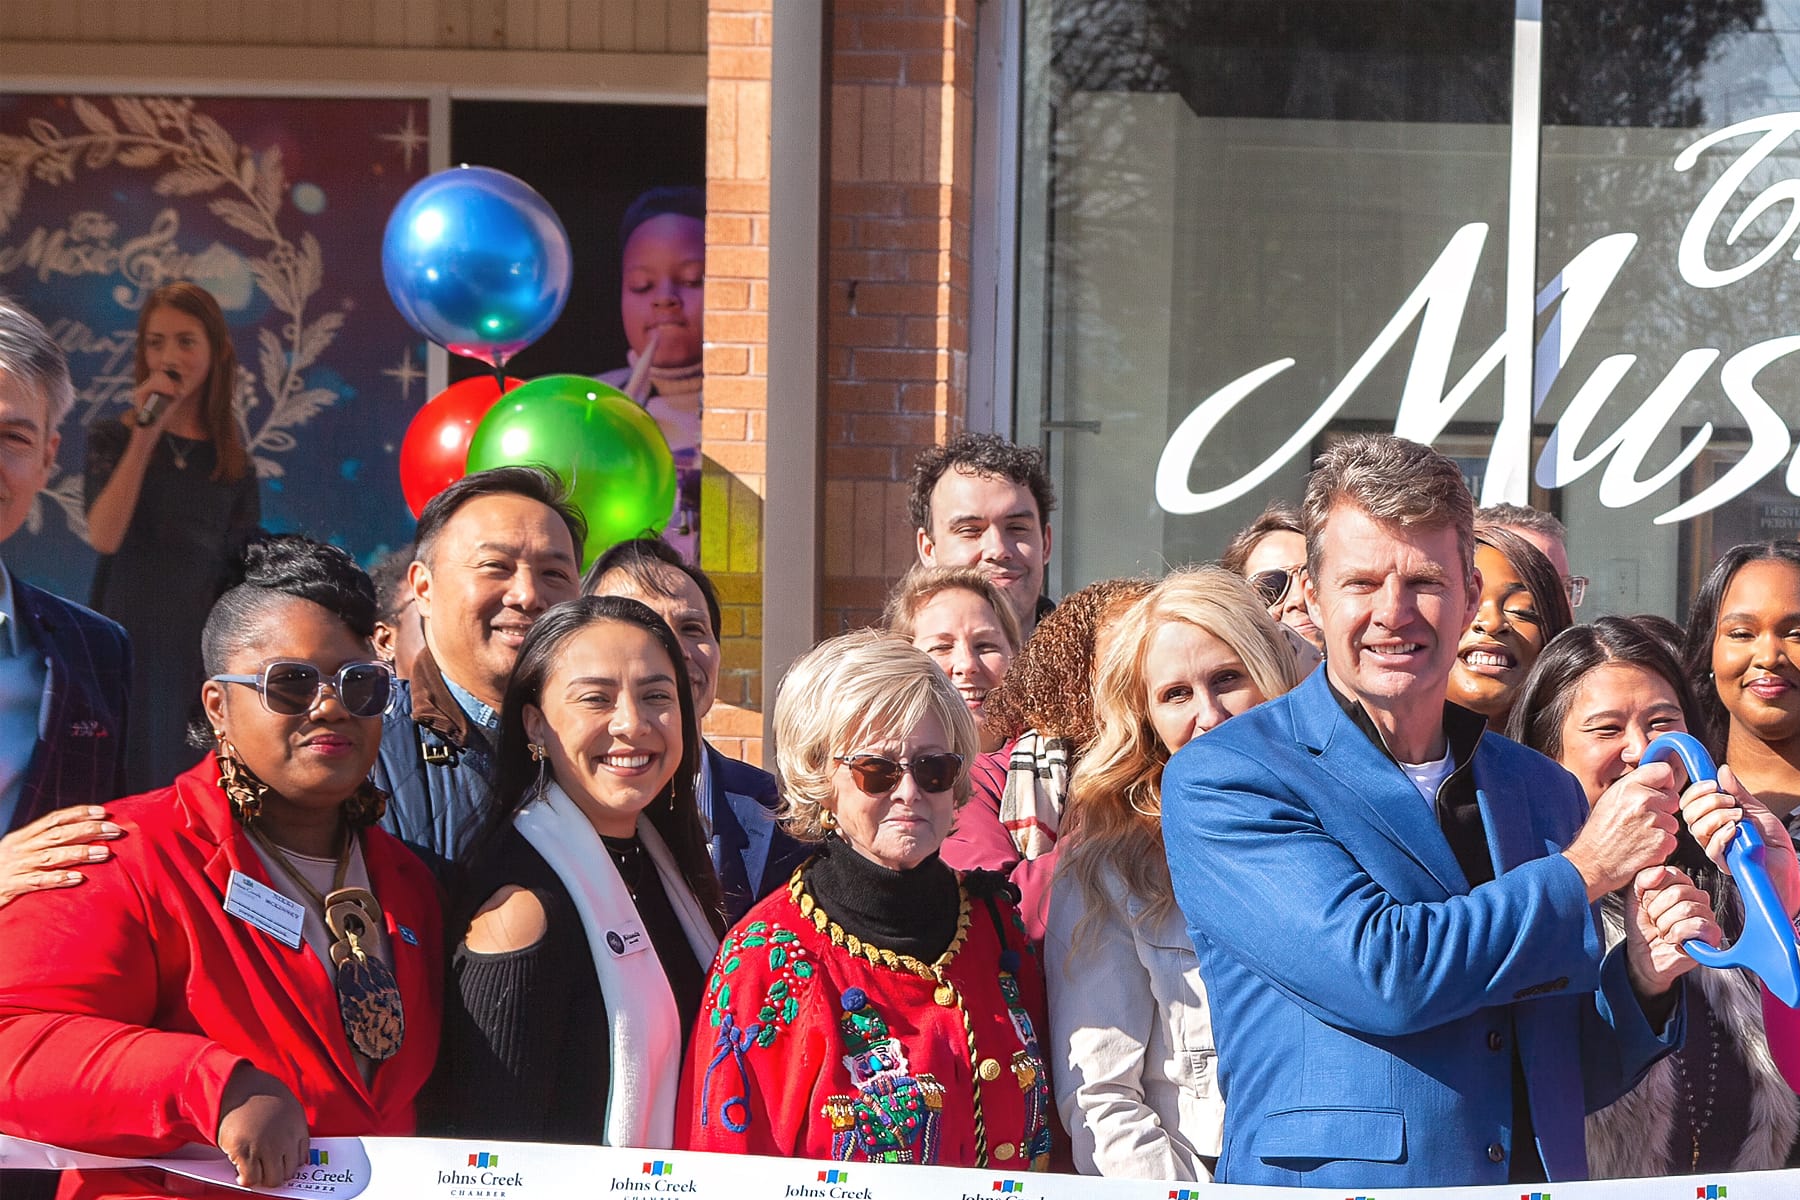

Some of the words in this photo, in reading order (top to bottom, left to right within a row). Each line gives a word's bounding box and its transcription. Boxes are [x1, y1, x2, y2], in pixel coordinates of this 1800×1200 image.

[310, 1168, 353, 1183] Creek
[437, 1170, 477, 1185] Johns
[480, 1172, 523, 1187] Creek
[287, 1181, 336, 1192] HAMBER
[610, 1177, 651, 1191] Johns
[654, 1179, 697, 1193] Creek
[785, 1184, 825, 1198] Johns
[829, 1187, 872, 1200] Creek
[450, 1189, 505, 1197] CHAMBER
